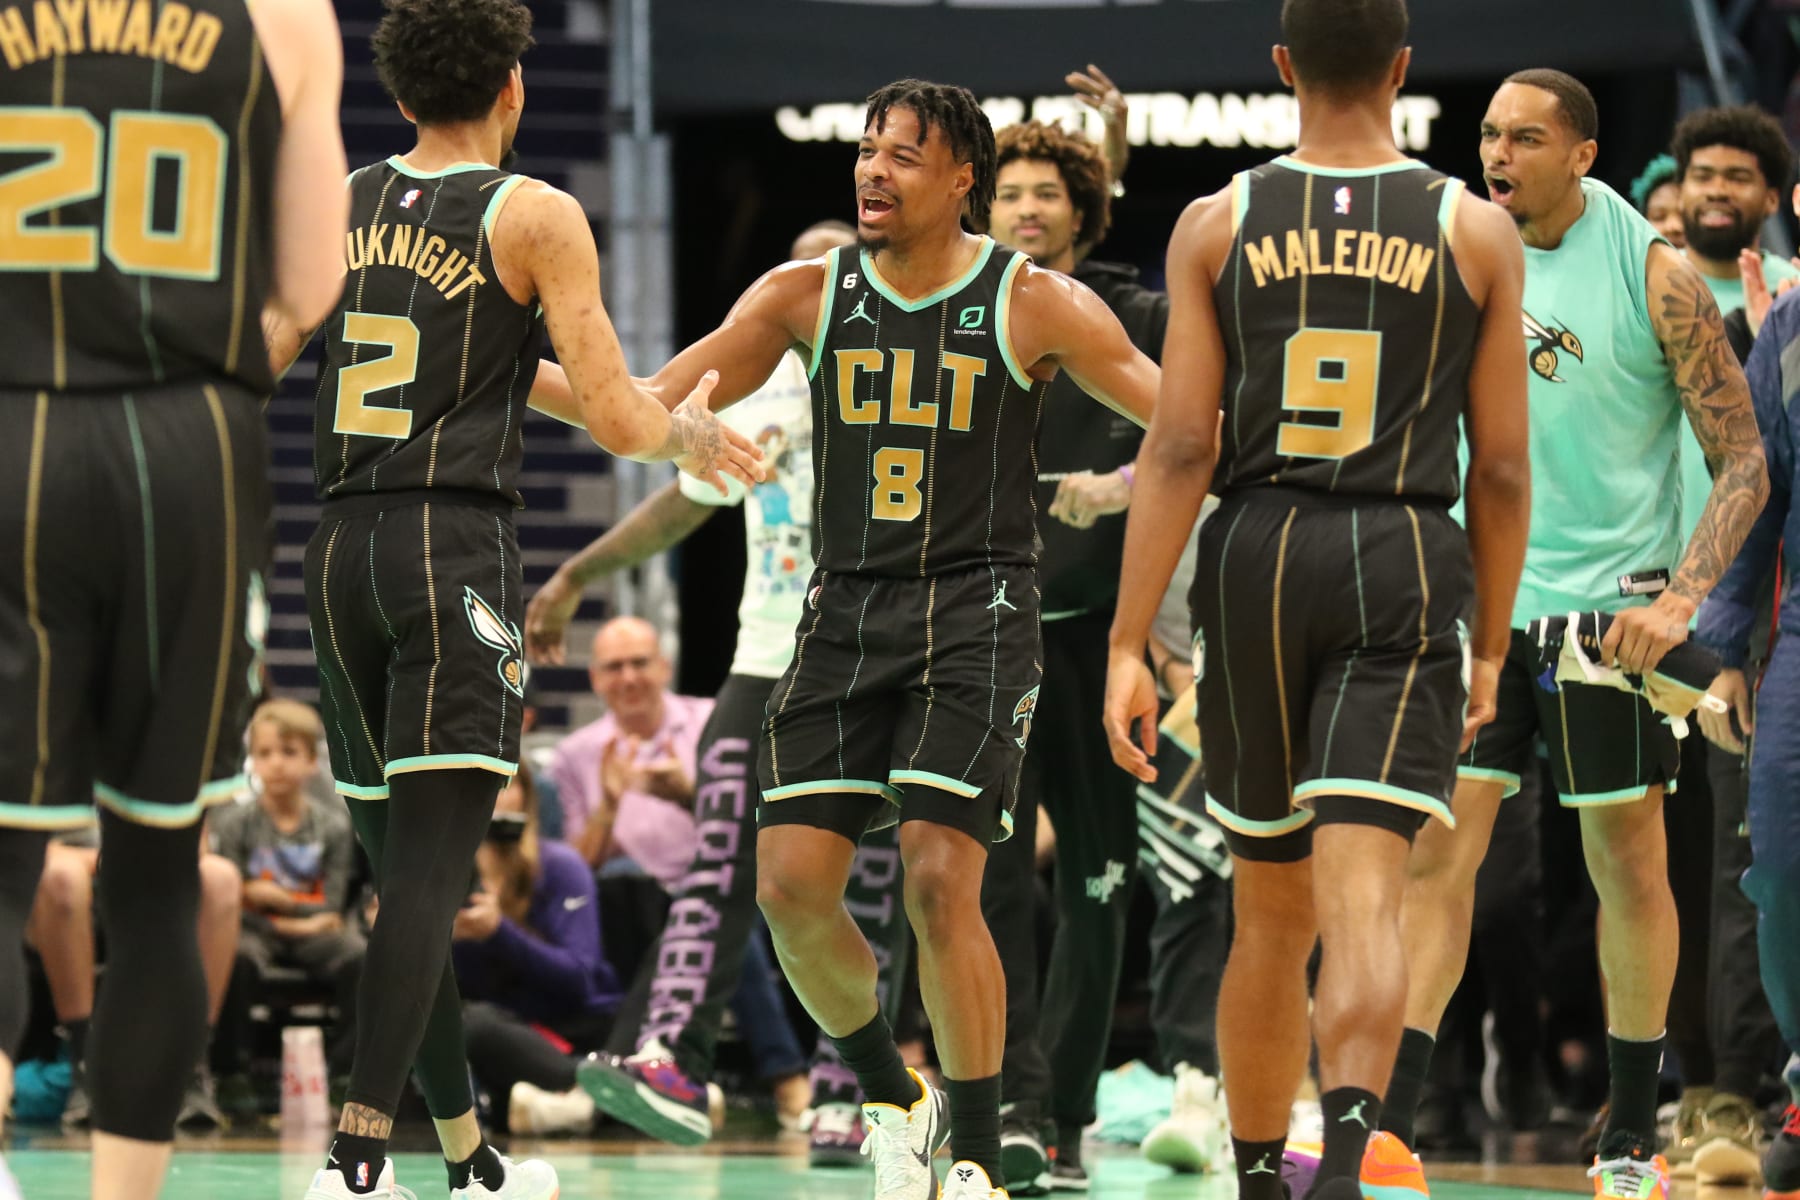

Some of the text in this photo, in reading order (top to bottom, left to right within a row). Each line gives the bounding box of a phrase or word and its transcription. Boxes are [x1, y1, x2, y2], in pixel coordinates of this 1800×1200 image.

[0, 0, 221, 72] HAYWARD
[1125, 93, 1442, 151] TRANST
[0, 107, 229, 280] 20
[343, 223, 487, 300] UKNIGHT
[842, 273, 858, 289] 6
[1244, 229, 1434, 294] MALEDON
[953, 328, 987, 336] lendingtree
[334, 311, 420, 439] 2
[834, 348, 987, 431] CLT
[1276, 328, 1382, 459] 9
[872, 447, 924, 521] 8
